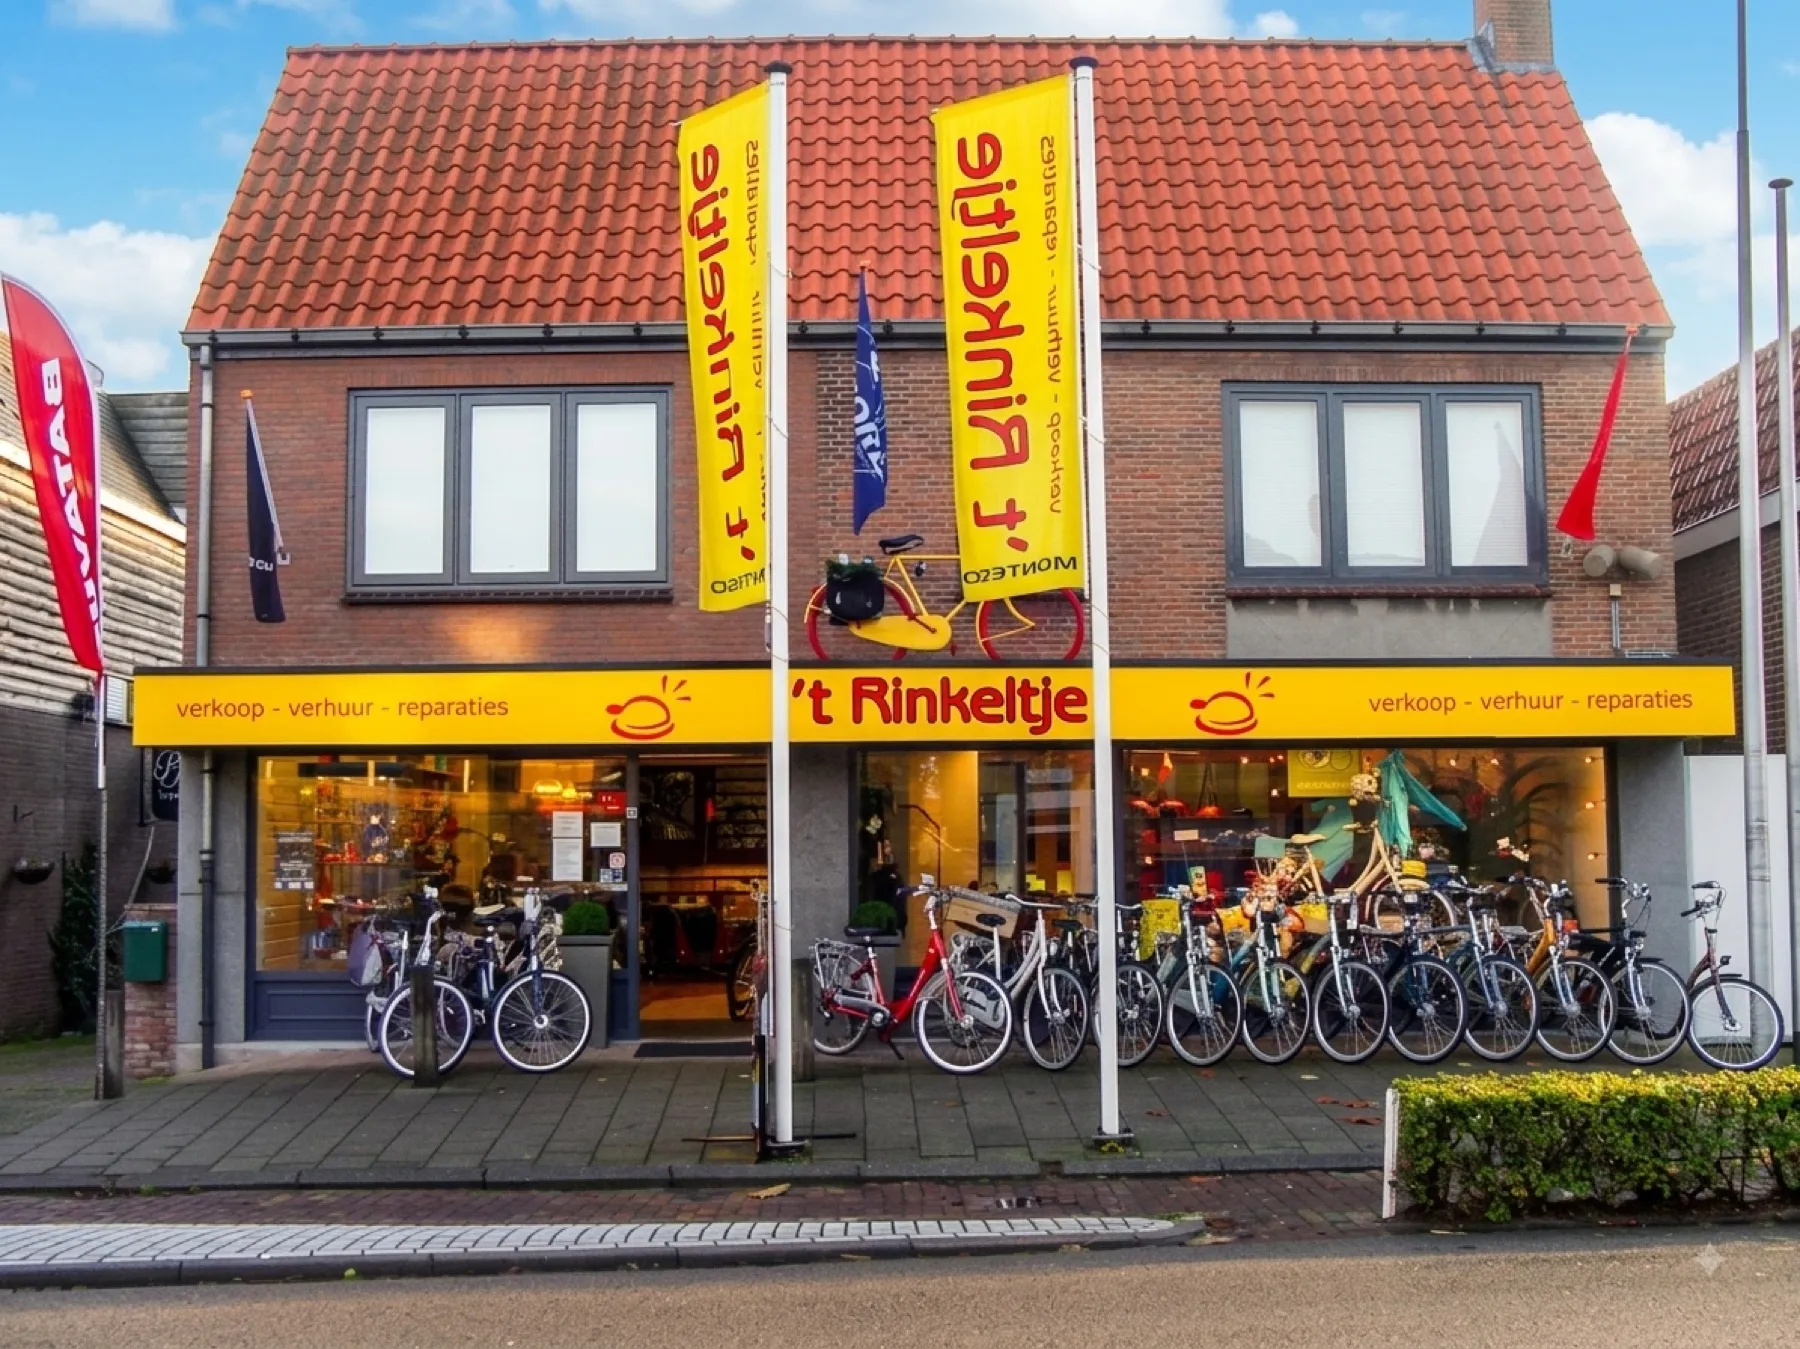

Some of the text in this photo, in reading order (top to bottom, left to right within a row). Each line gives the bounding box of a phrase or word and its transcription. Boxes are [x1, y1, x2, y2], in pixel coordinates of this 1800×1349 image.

[176, 698, 265, 722] verkoop
[288, 697, 374, 717] verhuur
[398, 697, 509, 721] reparaties
[792, 675, 1089, 736] 't Rinkeltje
[1368, 692, 1457, 716] verkoop
[1480, 690, 1565, 711] verhuur
[1587, 689, 1694, 713] reparaties
